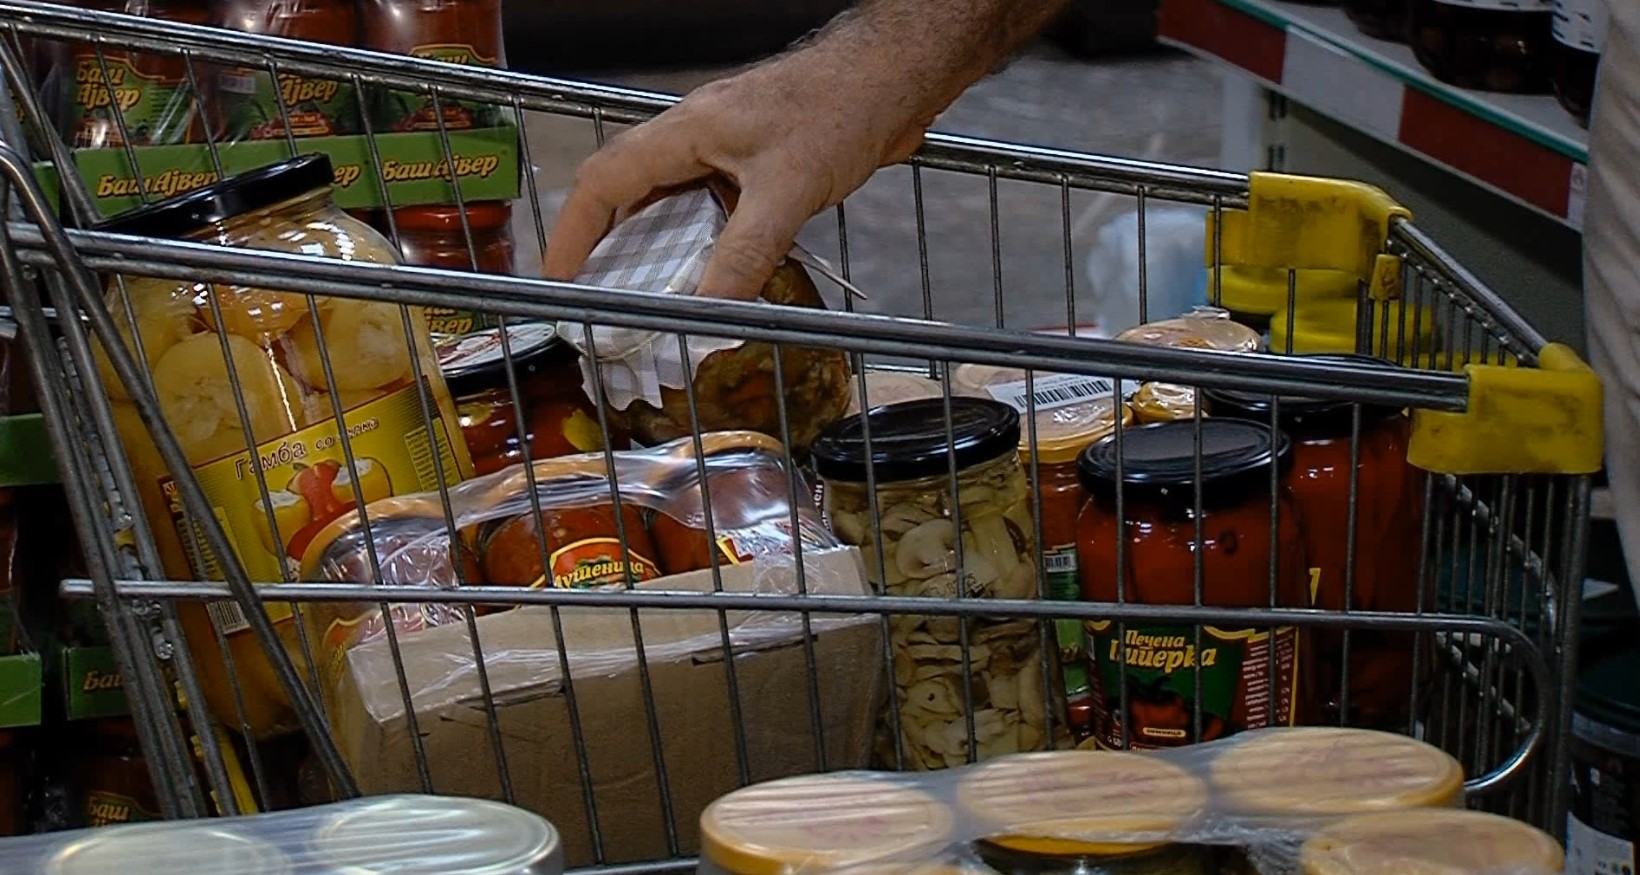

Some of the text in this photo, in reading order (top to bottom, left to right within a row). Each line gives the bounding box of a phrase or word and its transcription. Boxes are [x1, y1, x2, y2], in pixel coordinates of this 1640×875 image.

[382, 160, 433, 182] Баш
[433, 153, 499, 180] Ајвер
[1125, 629, 1185, 649] Печена
